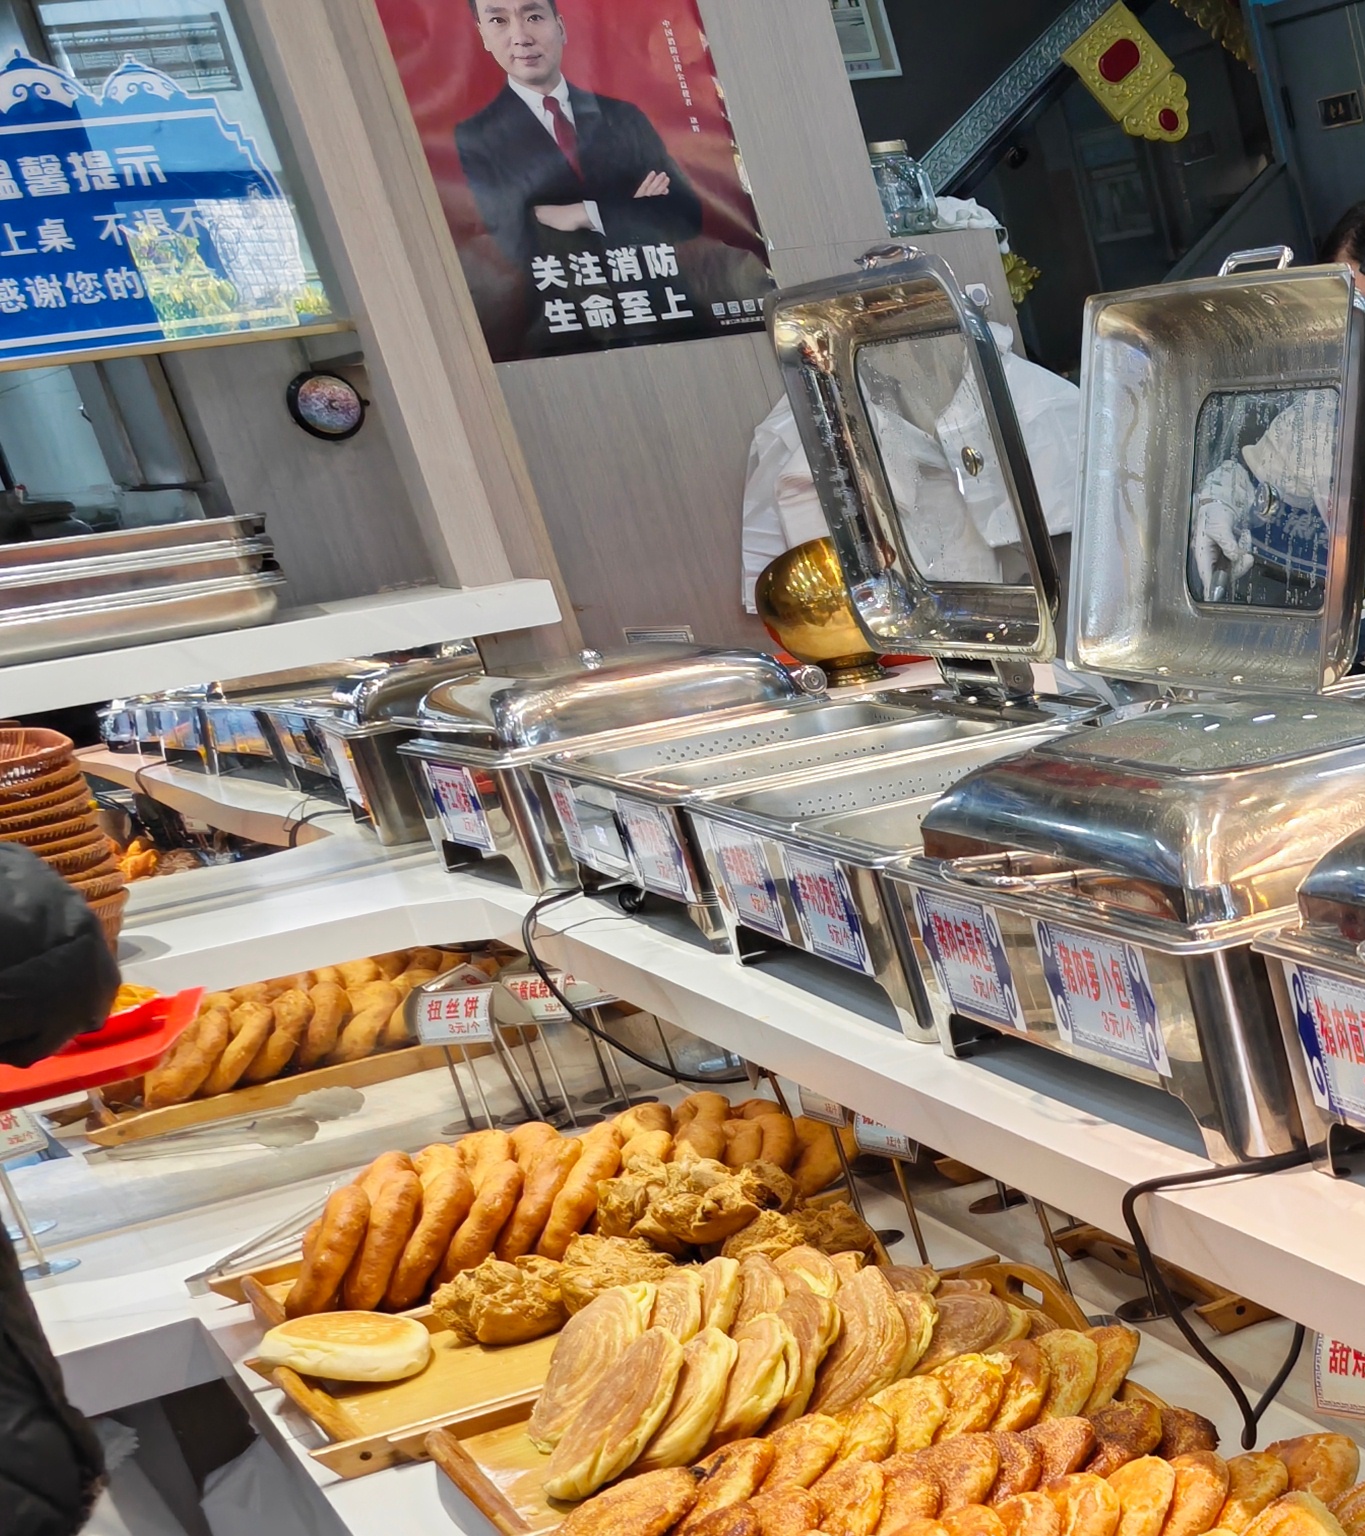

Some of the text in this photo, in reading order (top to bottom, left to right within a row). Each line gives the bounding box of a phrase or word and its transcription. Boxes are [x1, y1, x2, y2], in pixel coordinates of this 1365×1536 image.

[531, 243, 679, 291] 关注消防
[544, 287, 694, 333] 生命至上
[932, 912, 992, 972] 猪肉白菜包
[969, 974, 998, 1000] 3元/个
[1056, 940, 1131, 1010] 猪肉萝卜包
[449, 1023, 481, 1034] 3元/个
[1101, 1011, 1136, 1042] 3元/个
